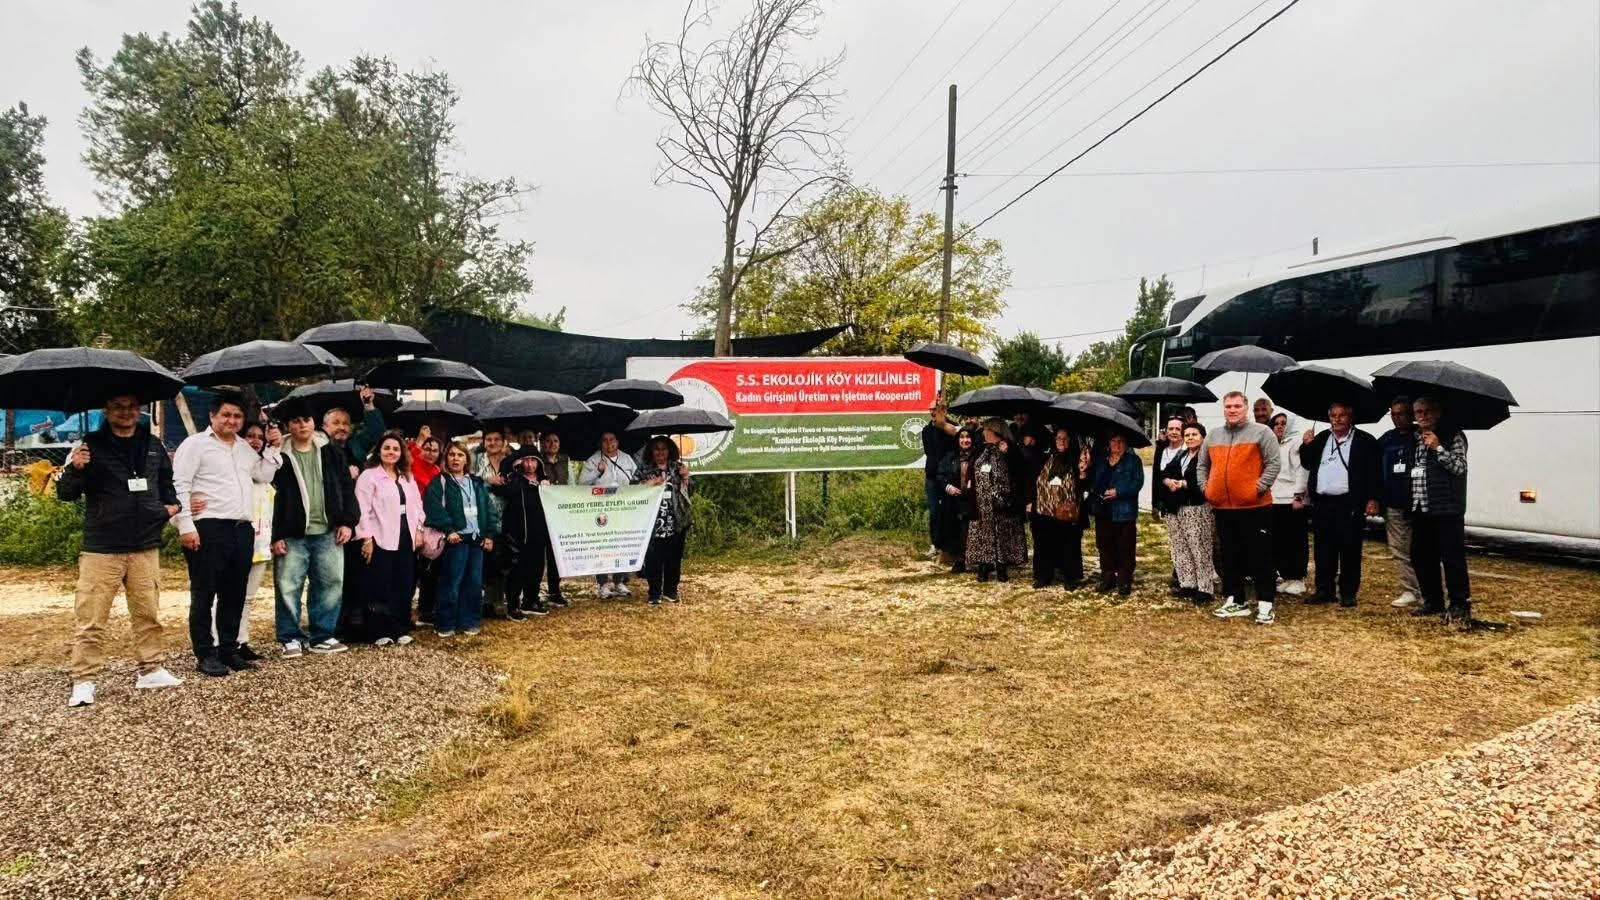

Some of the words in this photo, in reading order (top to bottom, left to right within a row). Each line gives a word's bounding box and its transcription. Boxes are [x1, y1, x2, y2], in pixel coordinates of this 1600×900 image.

[735, 374, 760, 387] S.S.
[762, 372, 824, 386] EKOLOJİK
[826, 371, 852, 386] KÖY
[854, 372, 921, 385] KIZILİNLER
[735, 391, 762, 403] Kadın
[763, 391, 797, 404] Girişimi
[798, 389, 829, 402] Üretim
[830, 393, 841, 401] ve
[842, 389, 873, 403] İşletme
[874, 390, 921, 403] Kooperatifi
